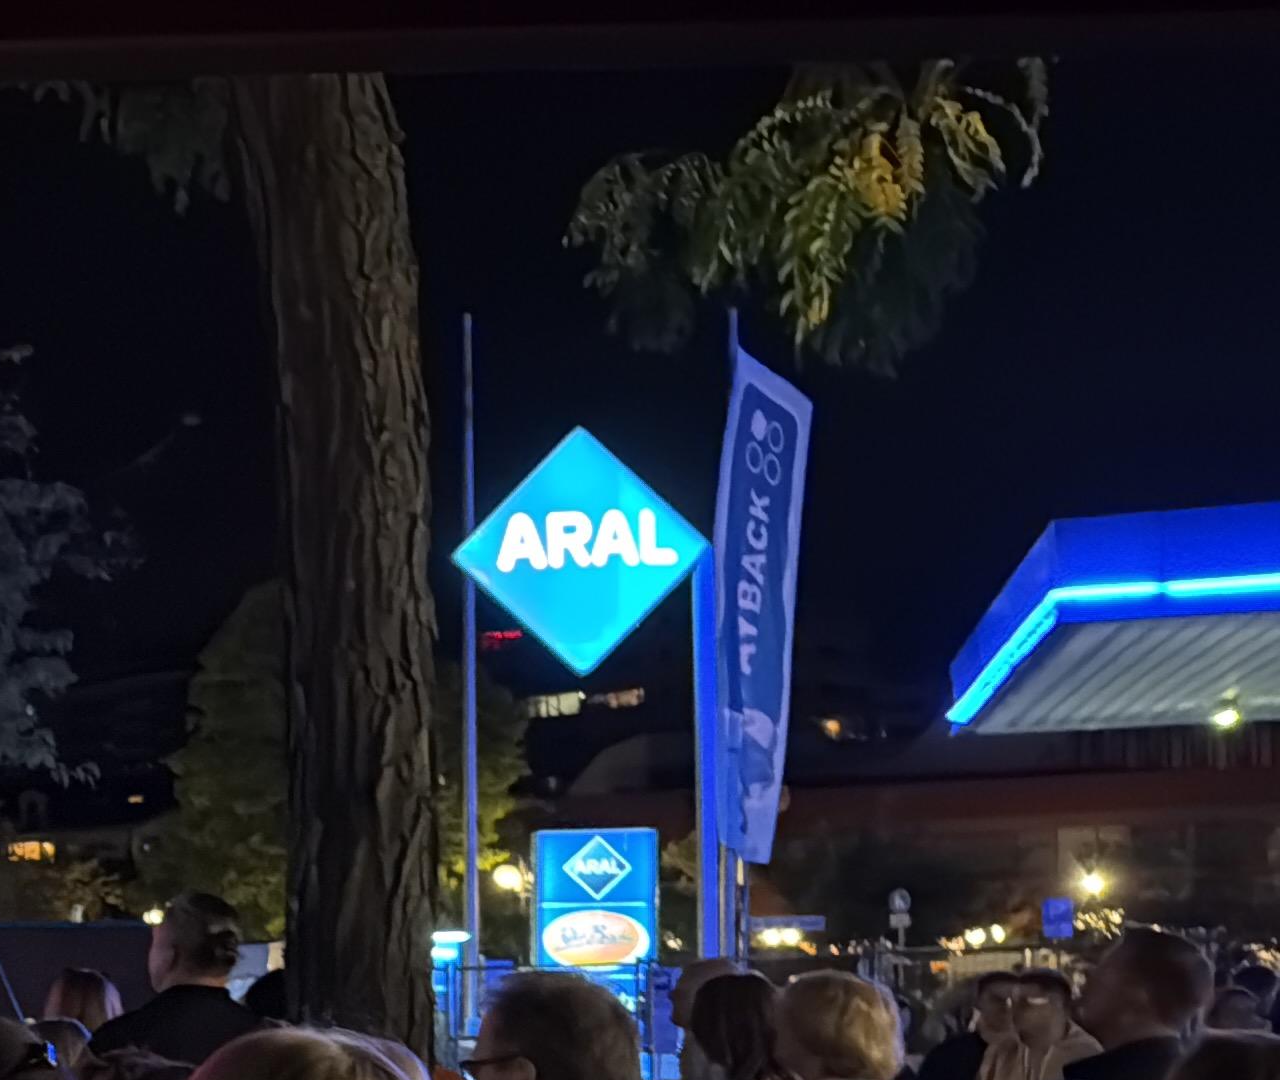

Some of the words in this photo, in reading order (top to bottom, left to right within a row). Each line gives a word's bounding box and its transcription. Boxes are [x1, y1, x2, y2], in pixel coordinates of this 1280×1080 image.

[496, 507, 679, 573] ARAL
[737, 487, 771, 676] AYBACK
[574, 857, 621, 875] ARAL
